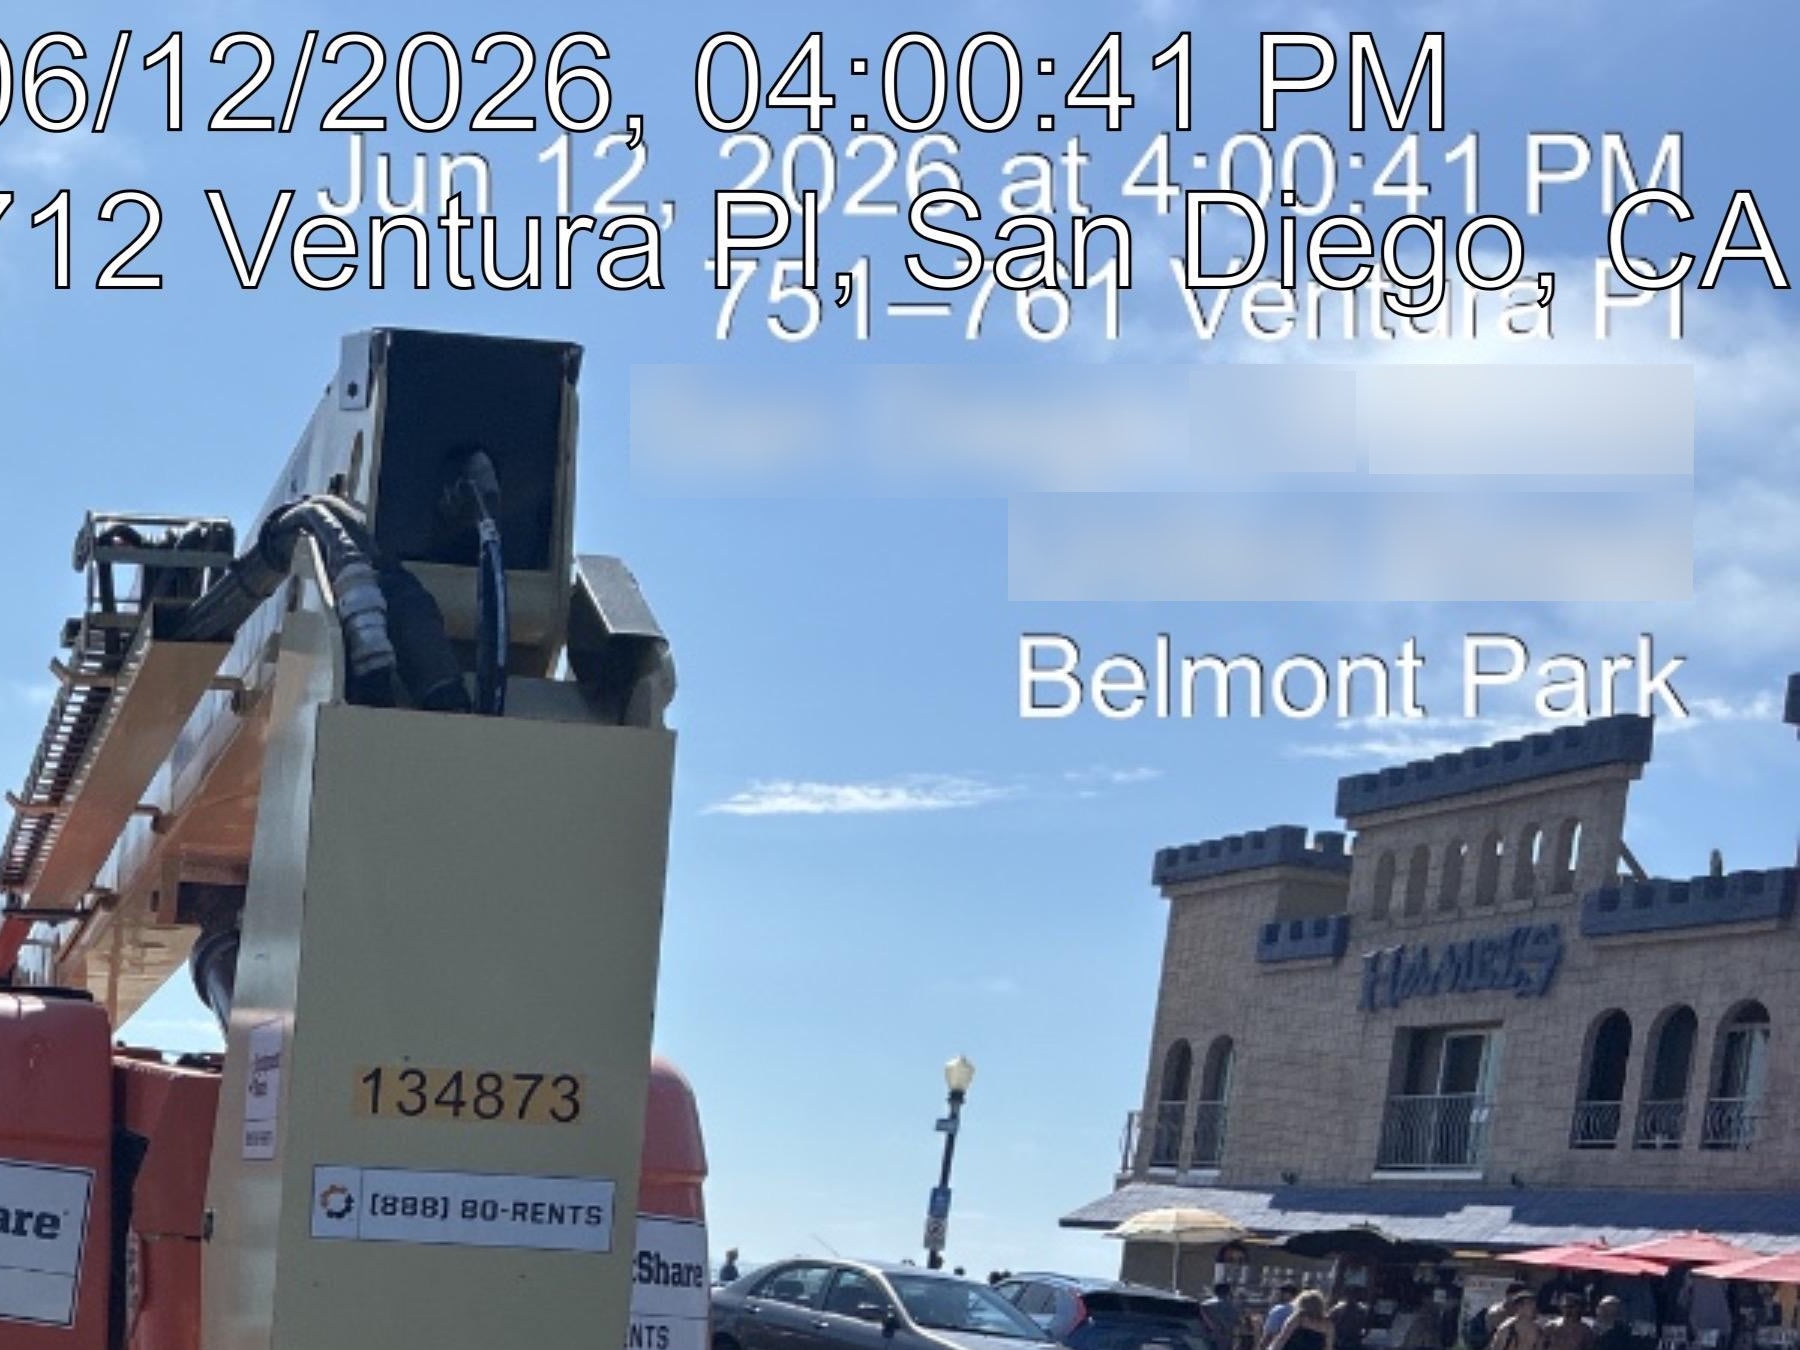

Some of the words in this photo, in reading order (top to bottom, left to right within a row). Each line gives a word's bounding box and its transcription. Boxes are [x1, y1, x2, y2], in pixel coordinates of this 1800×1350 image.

[362, 1066, 581, 1124] 134873
[460, 1197, 603, 1227] 80-RENTS
[624, 1323, 670, 1350] NTS
